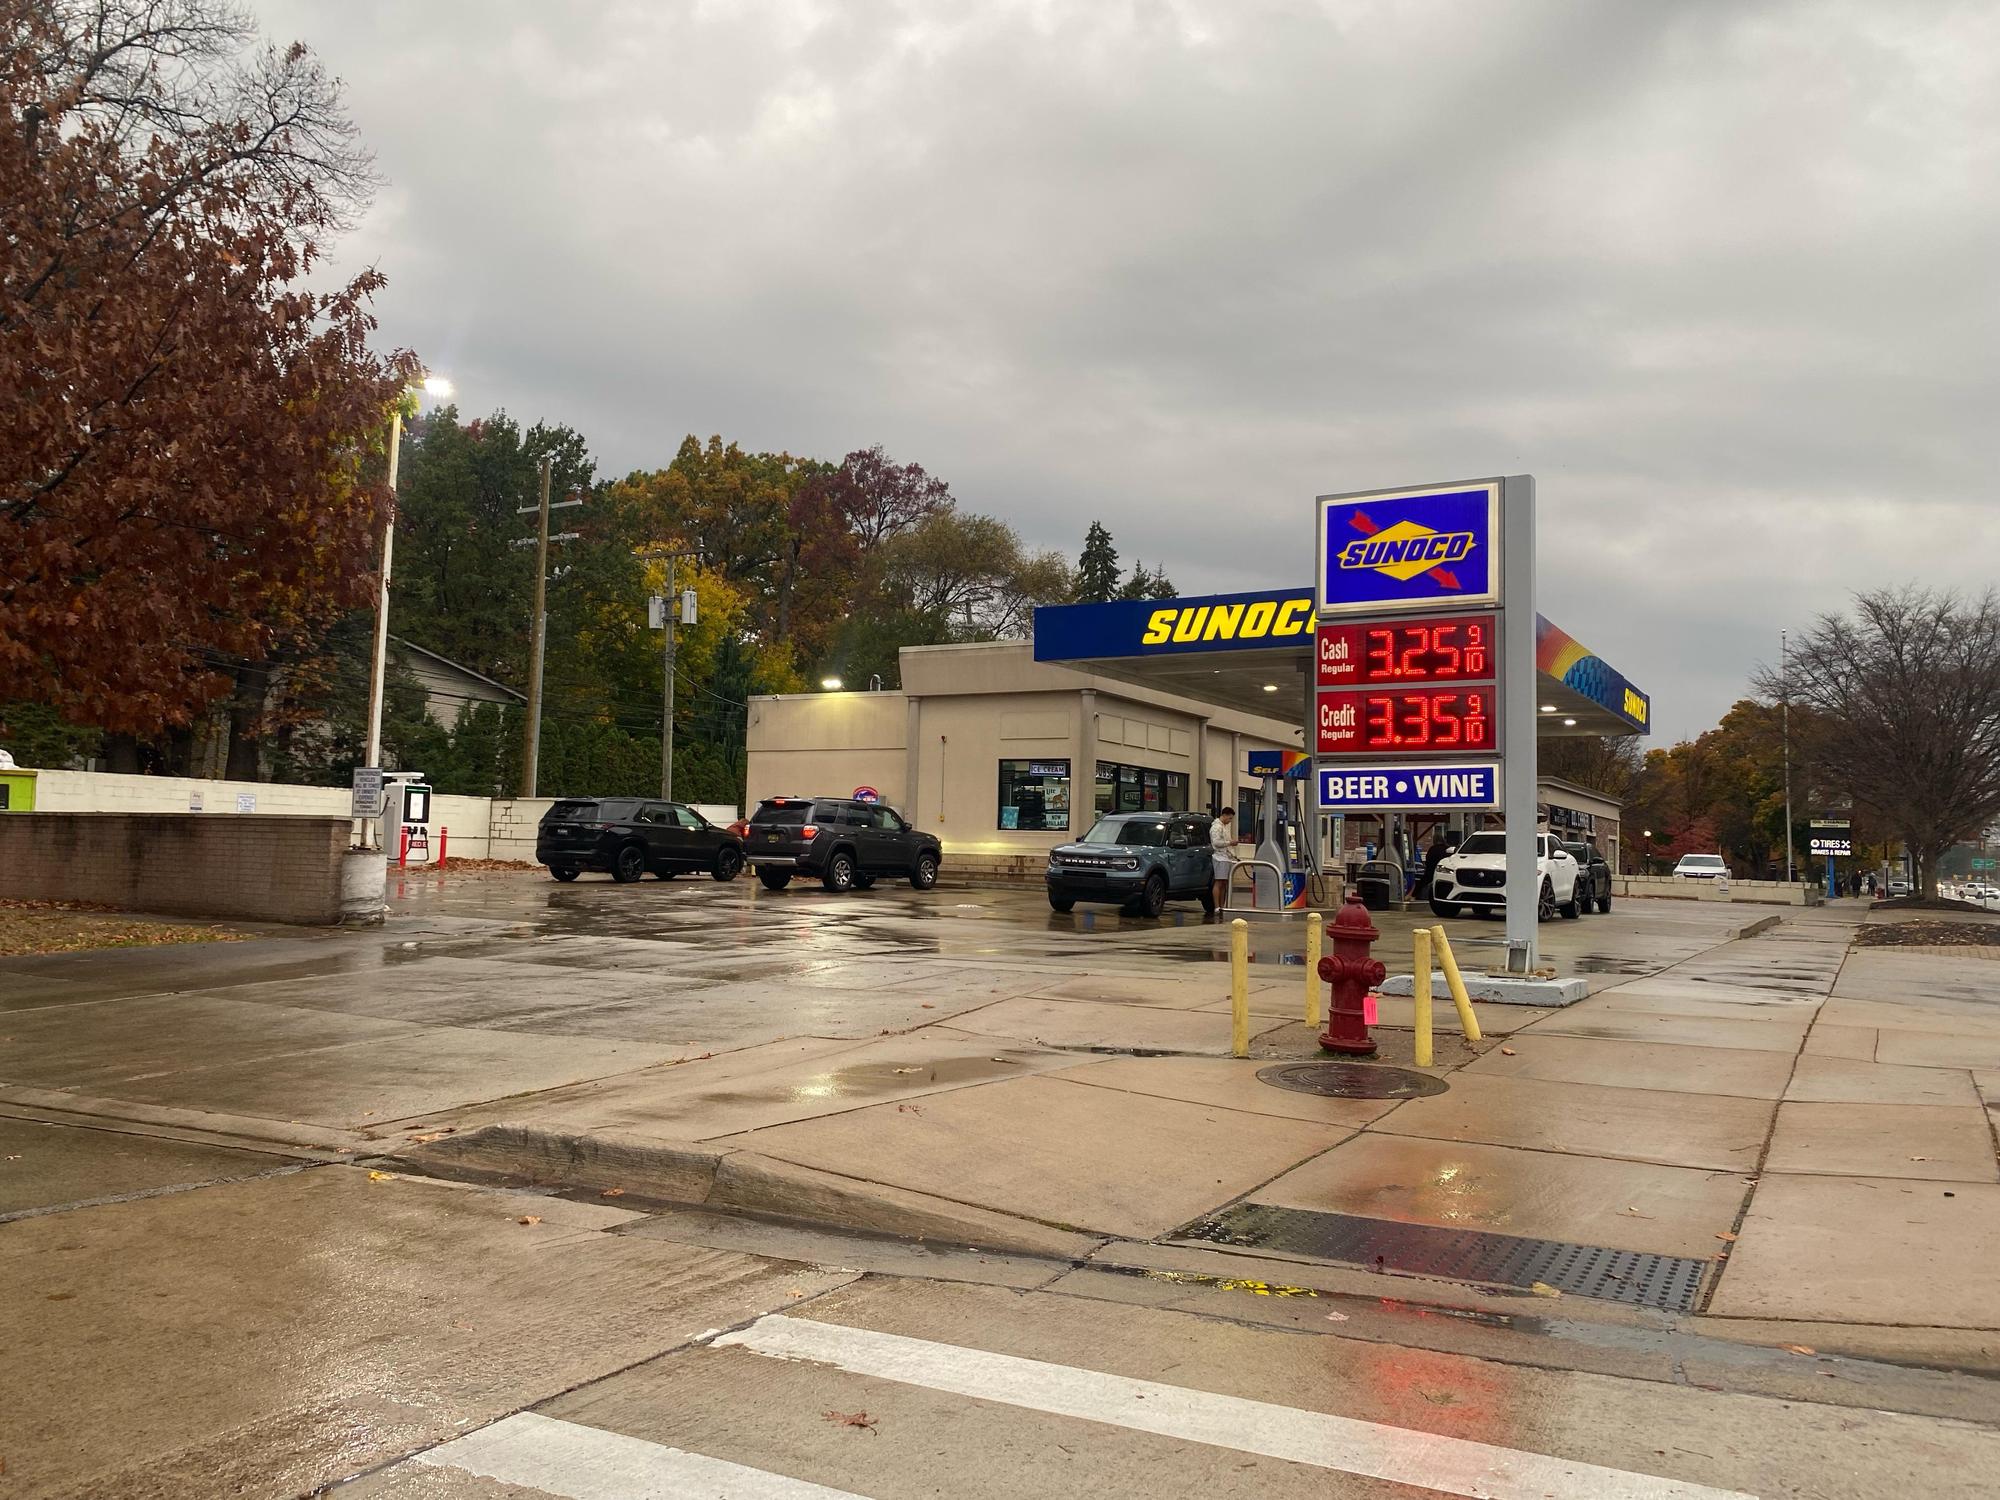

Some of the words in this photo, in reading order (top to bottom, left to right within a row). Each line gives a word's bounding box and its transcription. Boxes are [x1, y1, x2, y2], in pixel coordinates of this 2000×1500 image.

[1342, 533, 1470, 567] SUNOCO
[1141, 598, 1317, 645] SUNOC
[1321, 636, 1349, 661] Cash
[1369, 626, 1460, 677] 3.25
[1321, 662, 1355, 675] Regular
[1321, 703, 1356, 727] Credit
[1369, 695, 1460, 744] 3.35
[1321, 729, 1355, 741] Regular
[1044, 765, 1064, 774] CREAM
[1253, 766, 1280, 774] SELF
[1328, 776, 1389, 799] BEER
[1414, 774, 1485, 798] WINE
[1820, 839, 1841, 848] TIRES
